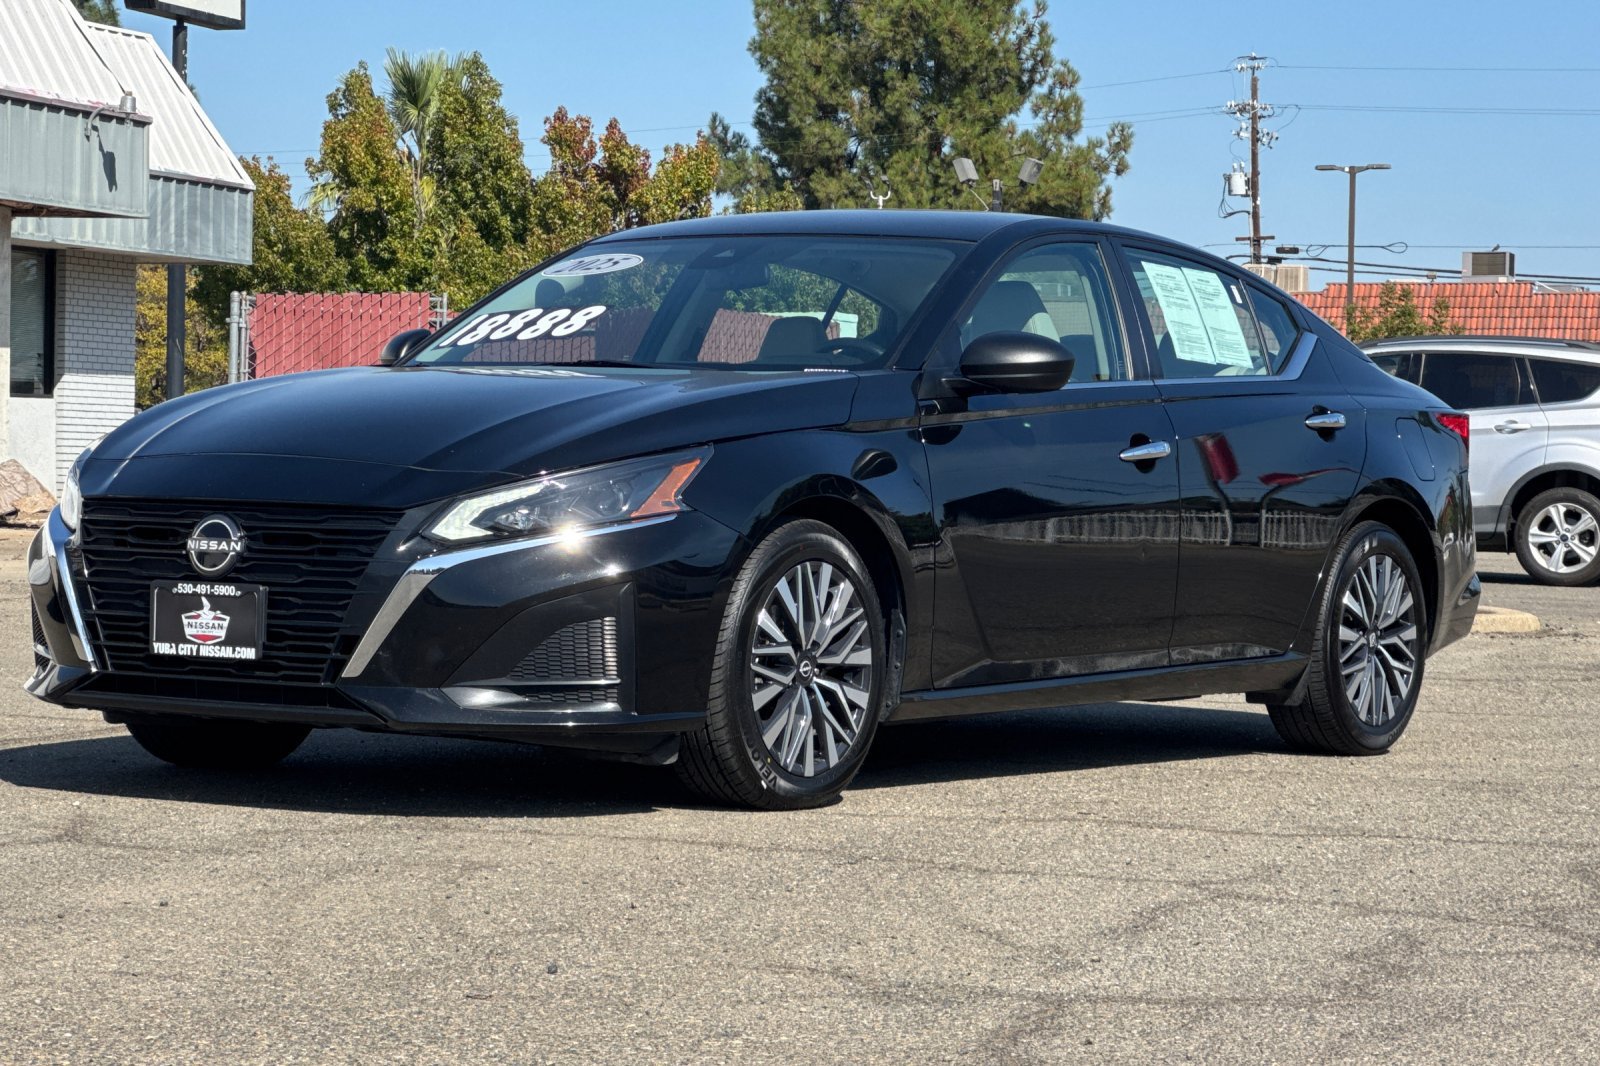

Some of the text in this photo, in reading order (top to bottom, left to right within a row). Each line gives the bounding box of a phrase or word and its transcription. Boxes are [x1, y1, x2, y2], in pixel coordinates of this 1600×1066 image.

[439, 305, 607, 347] 18888
[187, 539, 242, 551] NISSAN
[177, 583, 236, 596] 530-491-5900
[187, 621, 224, 631] NISSAN
[153, 642, 256, 660] YUBA CITY NISSAN.COM
